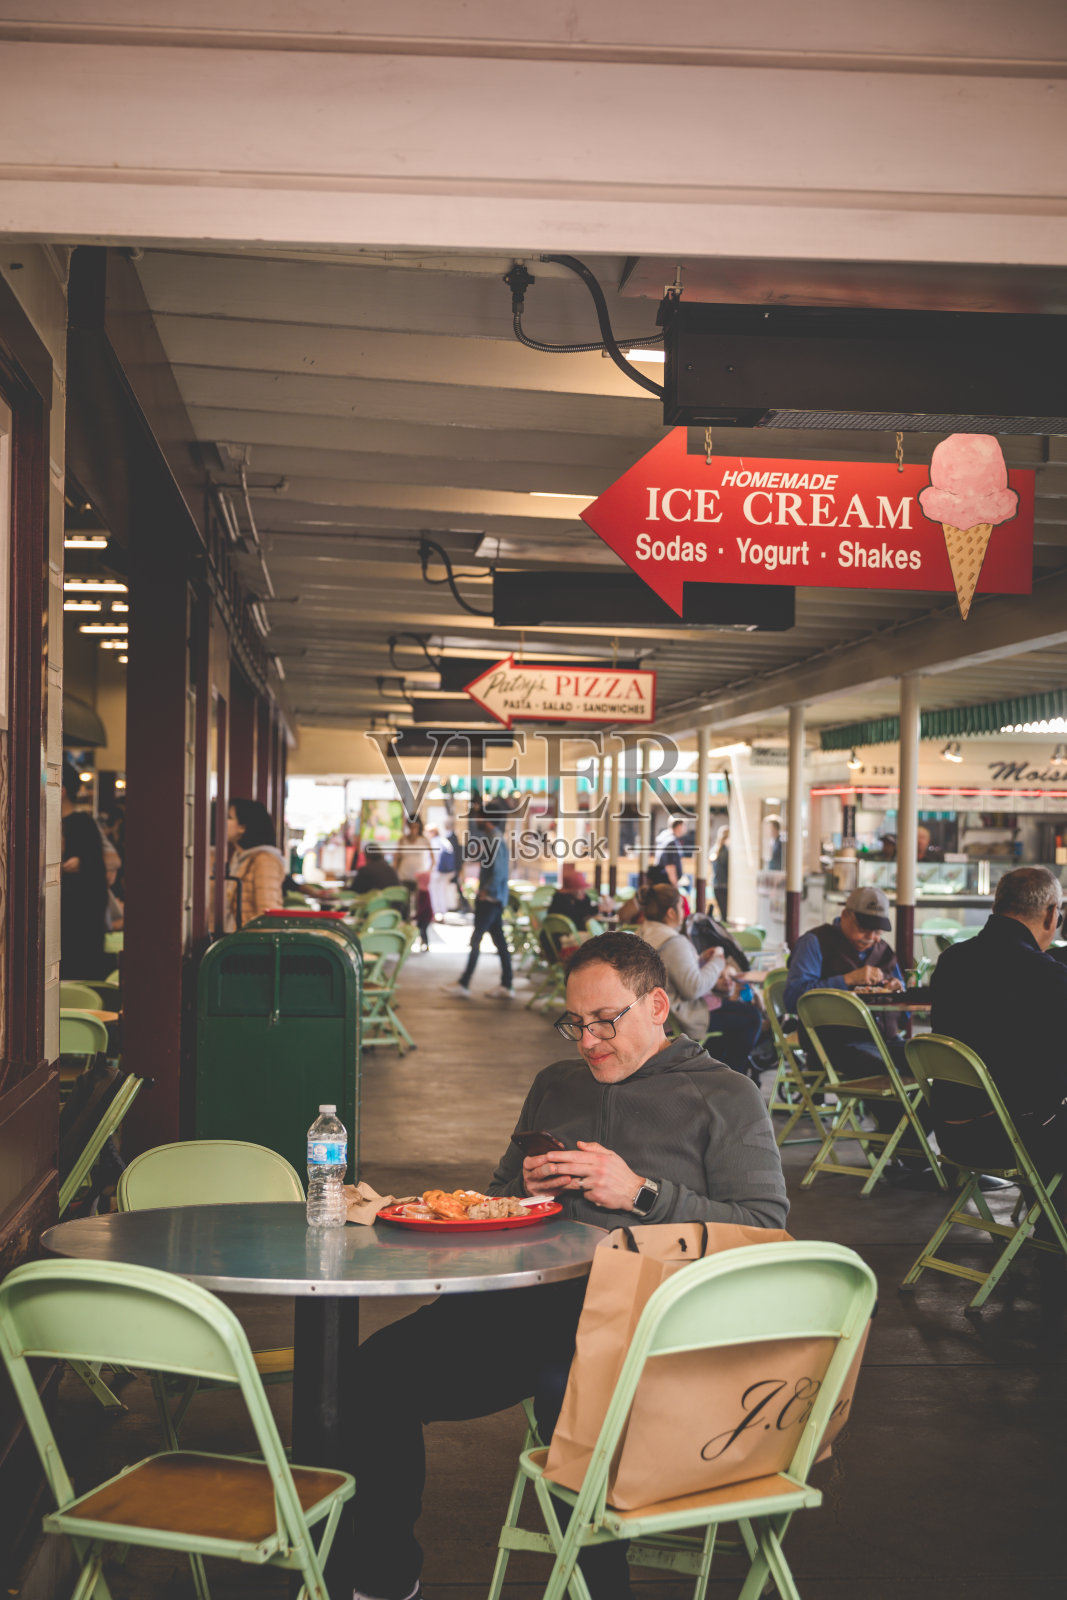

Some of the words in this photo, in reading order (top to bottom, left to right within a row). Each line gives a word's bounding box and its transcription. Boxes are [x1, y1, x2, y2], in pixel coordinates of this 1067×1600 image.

[720, 470, 839, 491] HOMEMADE
[645, 487, 723, 523] ICE
[742, 491, 914, 530] CREAM
[635, 533, 708, 562] Sodas
[736, 537, 809, 570] Yogurt
[838, 540, 922, 570] Shakes
[483, 671, 548, 700] Patsy's
[555, 675, 646, 700] PIZZA
[503, 699, 531, 709] PASTA
[542, 701, 573, 712] SALAD
[584, 702, 645, 714] SANDWICHES
[988, 760, 1067, 782] Mois
